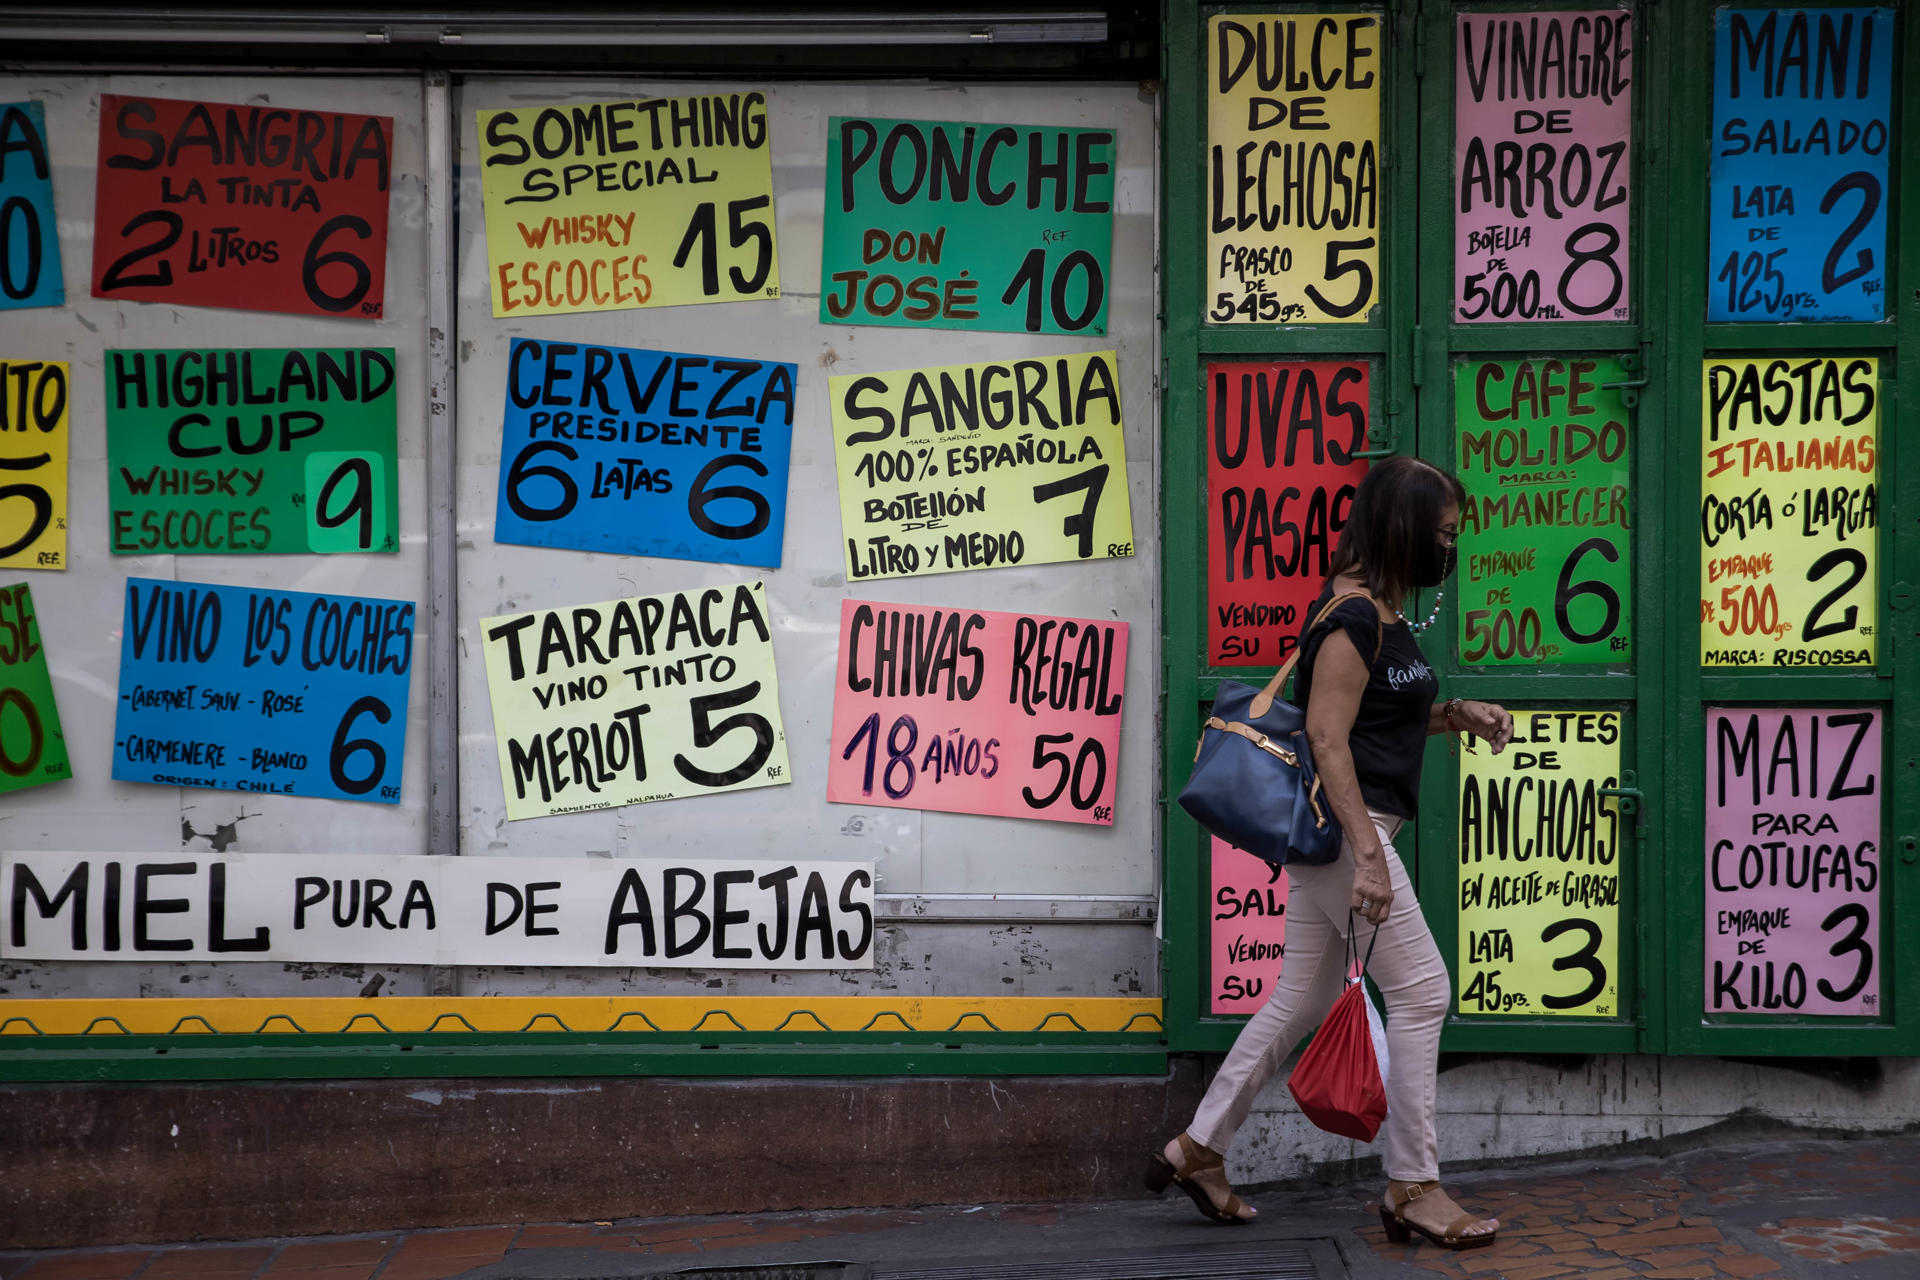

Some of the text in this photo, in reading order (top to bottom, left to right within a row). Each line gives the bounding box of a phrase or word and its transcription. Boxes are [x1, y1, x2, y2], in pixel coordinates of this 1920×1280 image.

[1218, 18, 1375, 93] DULCE
[1463, 13, 1631, 105] VINAGRE
[1730, 10, 1878, 100] MANÍ
[486, 92, 766, 167] SOMETHING
[1248, 96, 1331, 131] DE
[1514, 110, 1573, 134] DE
[1721, 117, 1886, 156] SALADO
[106, 101, 388, 191] SANGRIA
[840, 120, 1113, 213] PONCHE
[161, 177, 320, 212] LA TINTA
[504, 158, 718, 204] SPECIAL
[1212, 140, 1376, 233] LECHOSA
[1461, 136, 1627, 219] ARROZ
[1732, 185, 1794, 219] LATA
[517, 211, 635, 249] WHISKY
[673, 194, 773, 295] 15
[862, 226, 946, 264] DON
[1468, 225, 1531, 255] BOTELLA
[1749, 226, 1781, 242] DE
[1819, 171, 1882, 294] 2
[102, 210, 372, 312] 2 LITROS 6
[498, 254, 652, 312] ESCOCES
[1220, 244, 1292, 283] FRASCO
[1244, 279, 1267, 293] DE
[1304, 236, 1375, 318] 5
[1486, 258, 1508, 273] DE
[1557, 222, 1623, 316] 8
[827, 270, 979, 321] JOSÉ
[1001, 249, 1104, 331] 10
[113, 350, 394, 409] HIGHLAND
[510, 340, 793, 425] CERVEZA
[844, 356, 1120, 447] SANGRIA
[1709, 359, 1874, 441] PASTAS
[167, 411, 324, 458] CUP
[529, 411, 762, 452] PRESIDENTE
[1214, 366, 1365, 470] UVAS
[854, 433, 1103, 488] 100% ESPAÑOLA
[1462, 420, 1626, 473] MOLIDO
[1706, 435, 1874, 478] ITALIANAS
[119, 466, 264, 496] WHISKY
[315, 457, 373, 549] 9
[507, 440, 770, 540] 6 LATAS 6
[1499, 470, 1577, 485] MARCA:
[114, 506, 271, 550] ESCOCES
[864, 486, 985, 523] BOTELLÓN
[901, 518, 949, 532] DE
[1033, 464, 1109, 558] 7
[1460, 484, 1630, 535] AMANECER
[1702, 487, 1772, 547] CORTA
[1802, 483, 1875, 541] LARGA
[849, 535, 919, 577] LITRO
[944, 530, 1024, 568] MEDIO
[1469, 547, 1537, 582] EMPAQUE
[1708, 552, 1773, 583] EMPAQUE
[1218, 602, 1296, 628] VENDIDO
[1486, 586, 1512, 606] DE
[1554, 537, 1620, 645] 6
[1701, 599, 1715, 624] DE
[1802, 547, 1867, 642] 2
[130, 585, 413, 675] VINO LOS COCHES
[488, 581, 770, 681] TARAPACÁ
[1218, 635, 1260, 660] SU
[532, 653, 736, 710] VINO TINTO
[848, 604, 1122, 716] CHIVAS REGAL
[1704, 648, 1871, 666] MARCA: RISCOSSA
[201, 688, 241, 712] SAUV.
[261, 684, 309, 718] ROSÉ
[329, 695, 392, 795] 6
[508, 703, 651, 802] MERLOT
[674, 680, 774, 787] 5
[842, 712, 1000, 799] 18 AÑOS
[1718, 712, 1874, 807] MAIZ
[252, 747, 307, 773] BLANCO
[1022, 732, 1106, 811] 50
[1513, 751, 1561, 770] DE
[1462, 774, 1617, 865] ANCHOAS
[1752, 813, 1839, 836] PARA
[1462, 871, 1618, 910] EN ACEITE DE GIRASOL
[1711, 839, 1877, 893] COTUFAS
[10, 861, 873, 961] MIEL PURA DE ABEJAS
[1215, 887, 1285, 920] SAL
[1718, 908, 1791, 936] EMPAQUE
[1228, 935, 1285, 964] VENDID
[1469, 929, 1513, 964] LATA
[1541, 917, 1607, 1010] 3
[1738, 939, 1766, 956] DE
[1816, 903, 1873, 1002] 3
[1218, 976, 1262, 1000] SU
[1714, 960, 1807, 1010] KILO
